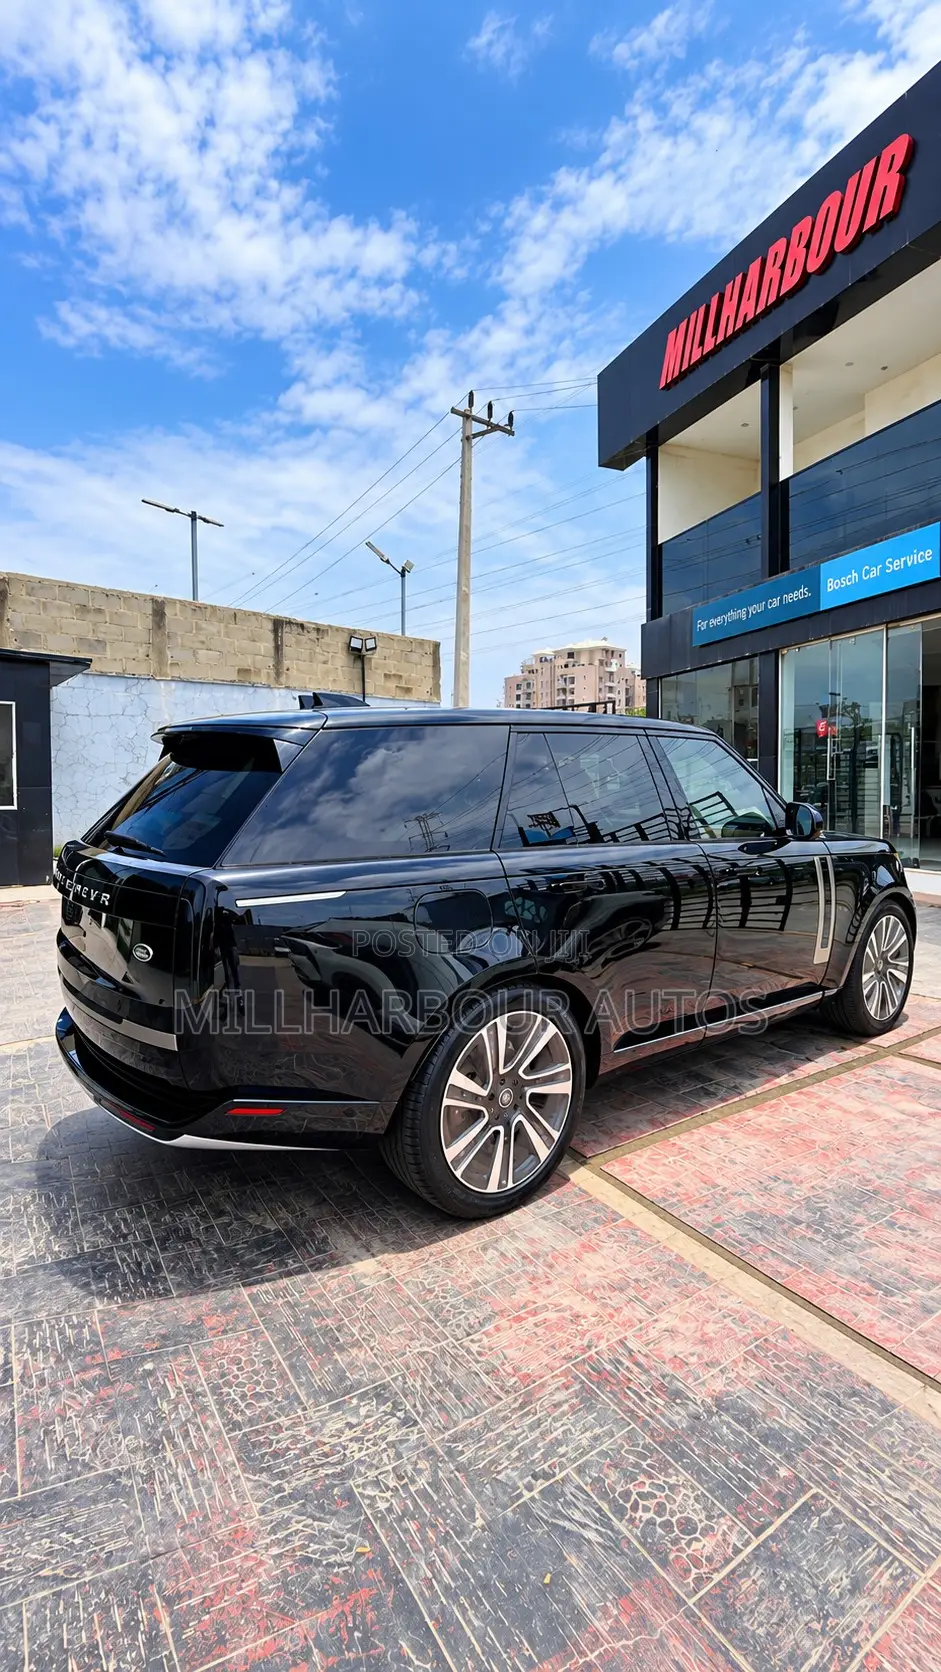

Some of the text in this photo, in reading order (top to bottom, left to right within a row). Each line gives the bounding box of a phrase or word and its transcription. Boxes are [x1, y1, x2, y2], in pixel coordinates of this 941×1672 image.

[659, 133, 914, 390] MILLHARBOUR
[827, 547, 933, 592] Bosch Car Service
[696, 584, 812, 632] For everything your car needs.
